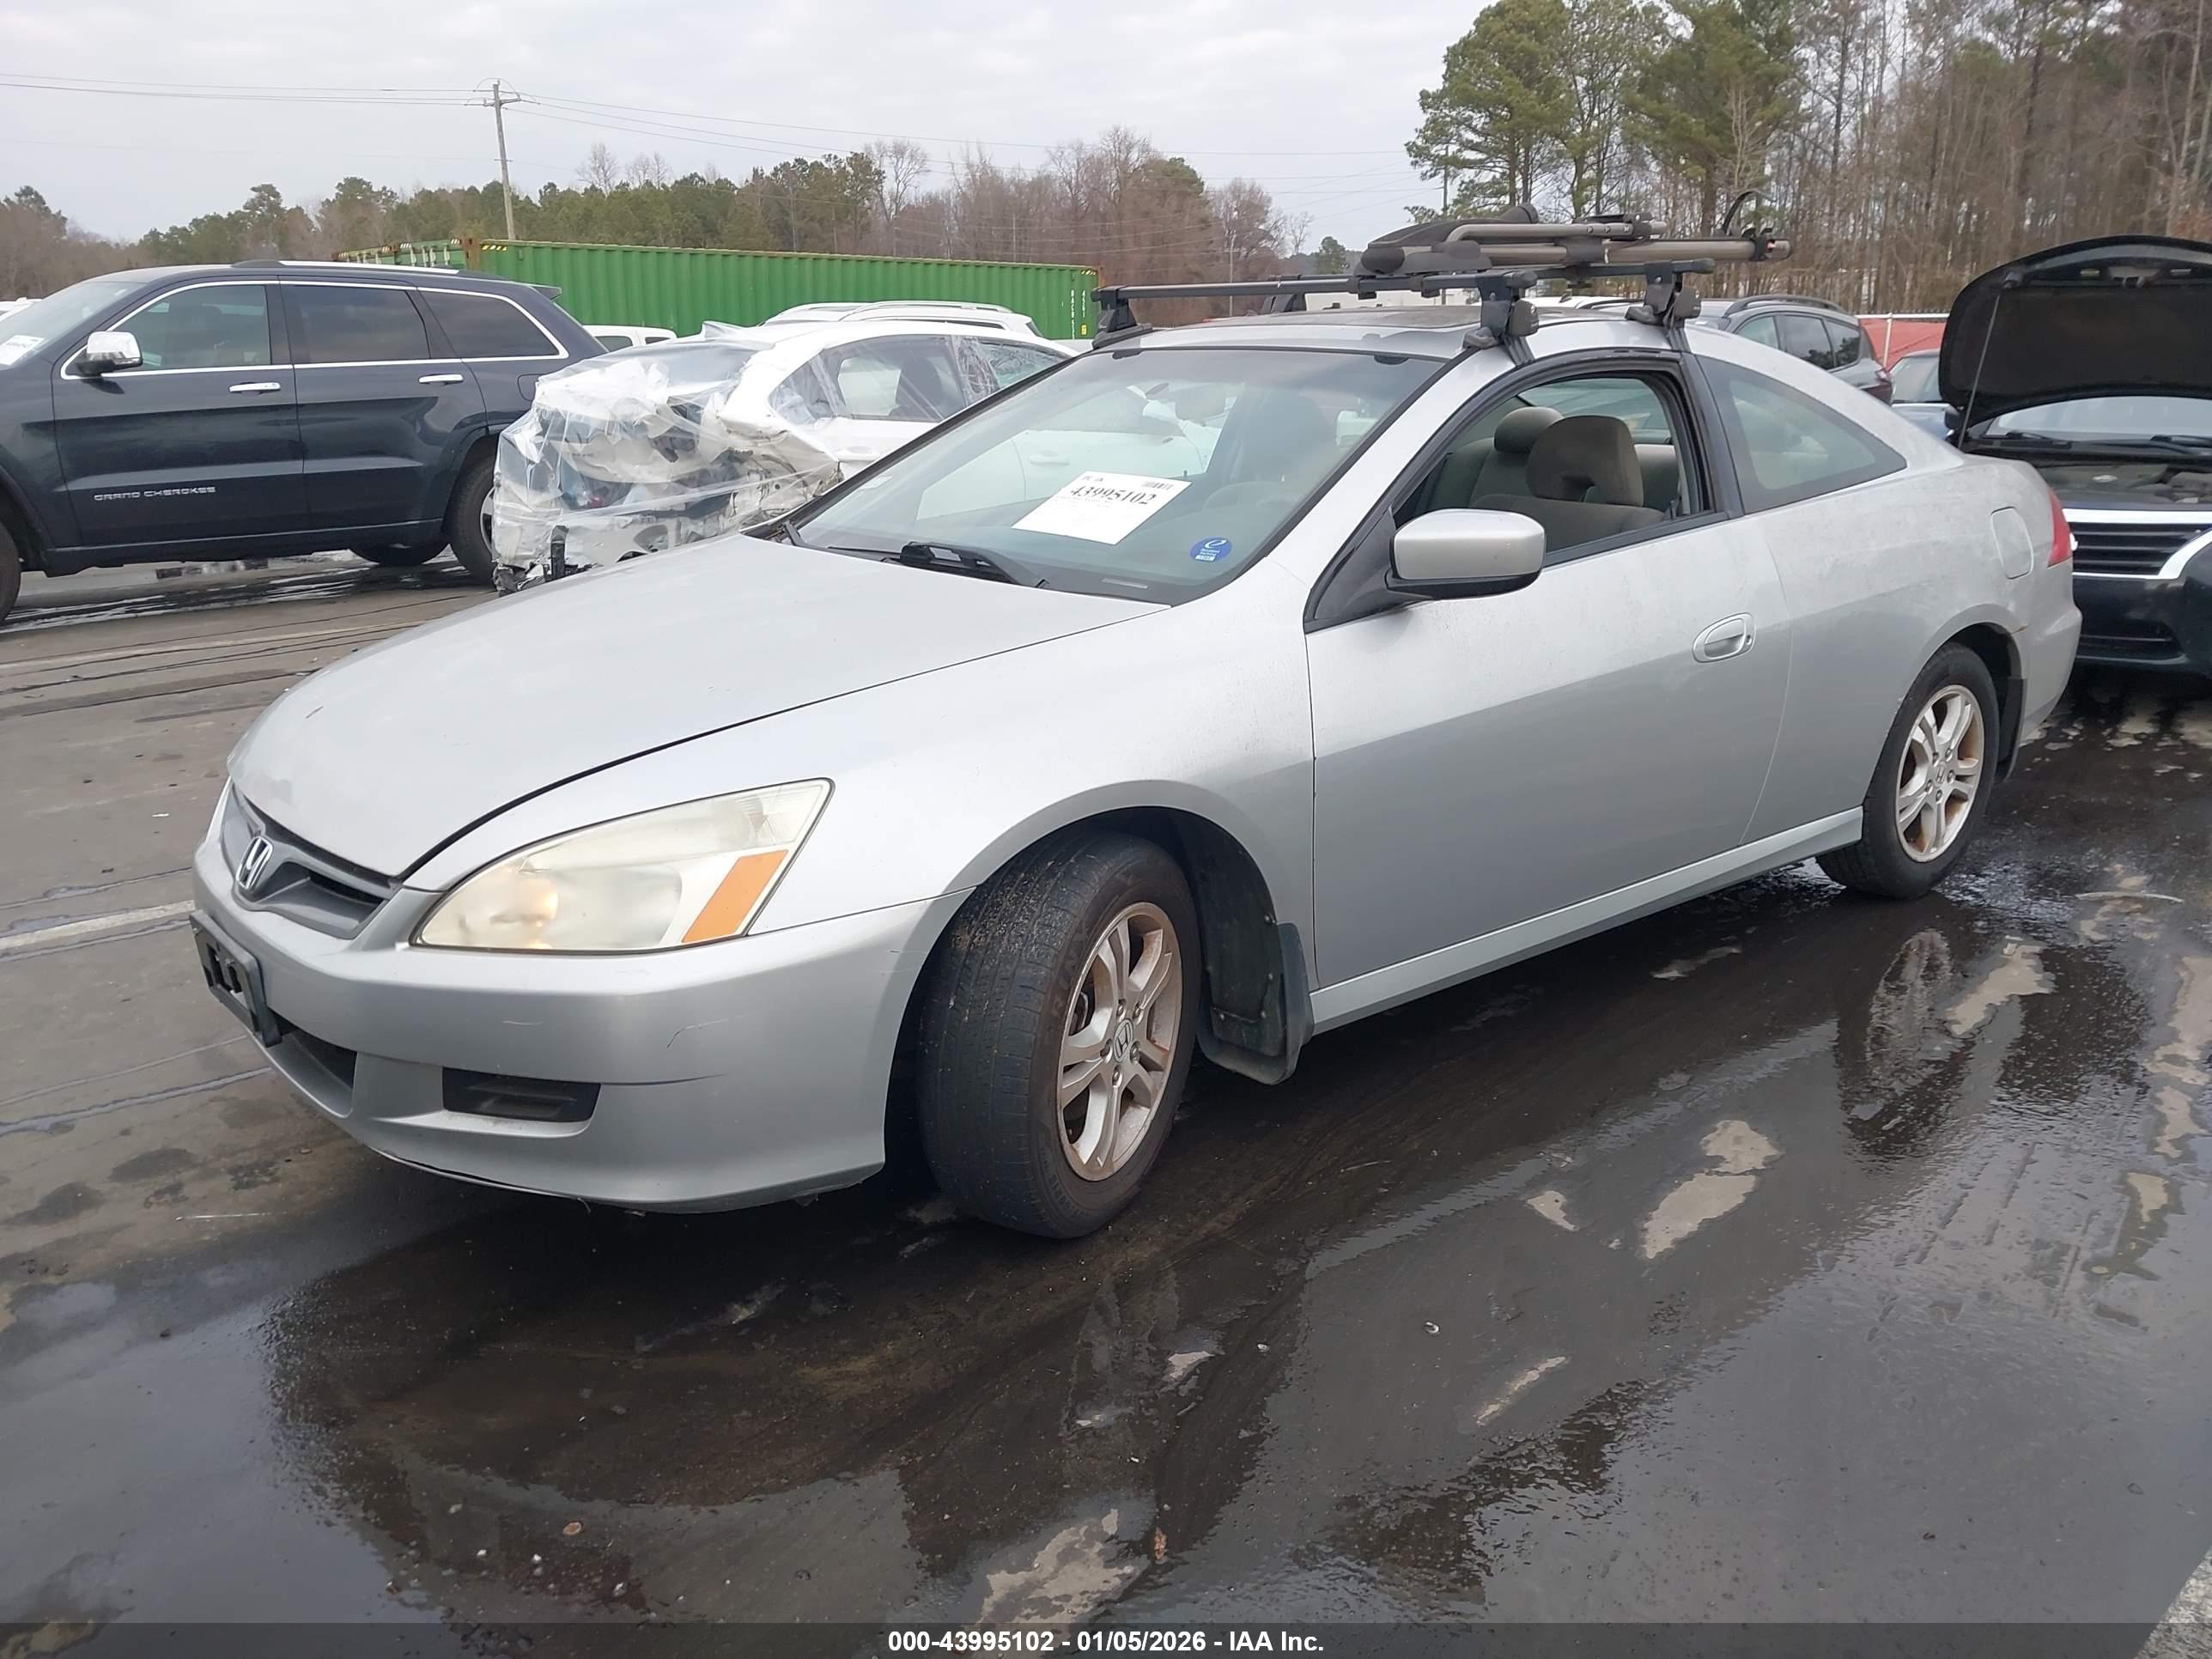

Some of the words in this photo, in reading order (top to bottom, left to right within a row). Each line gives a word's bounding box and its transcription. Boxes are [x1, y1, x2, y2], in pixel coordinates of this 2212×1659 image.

[94, 491, 140, 501] GRAND
[143, 486, 216, 497] CHEROKEE
[1071, 485, 1157, 505] 43995102
